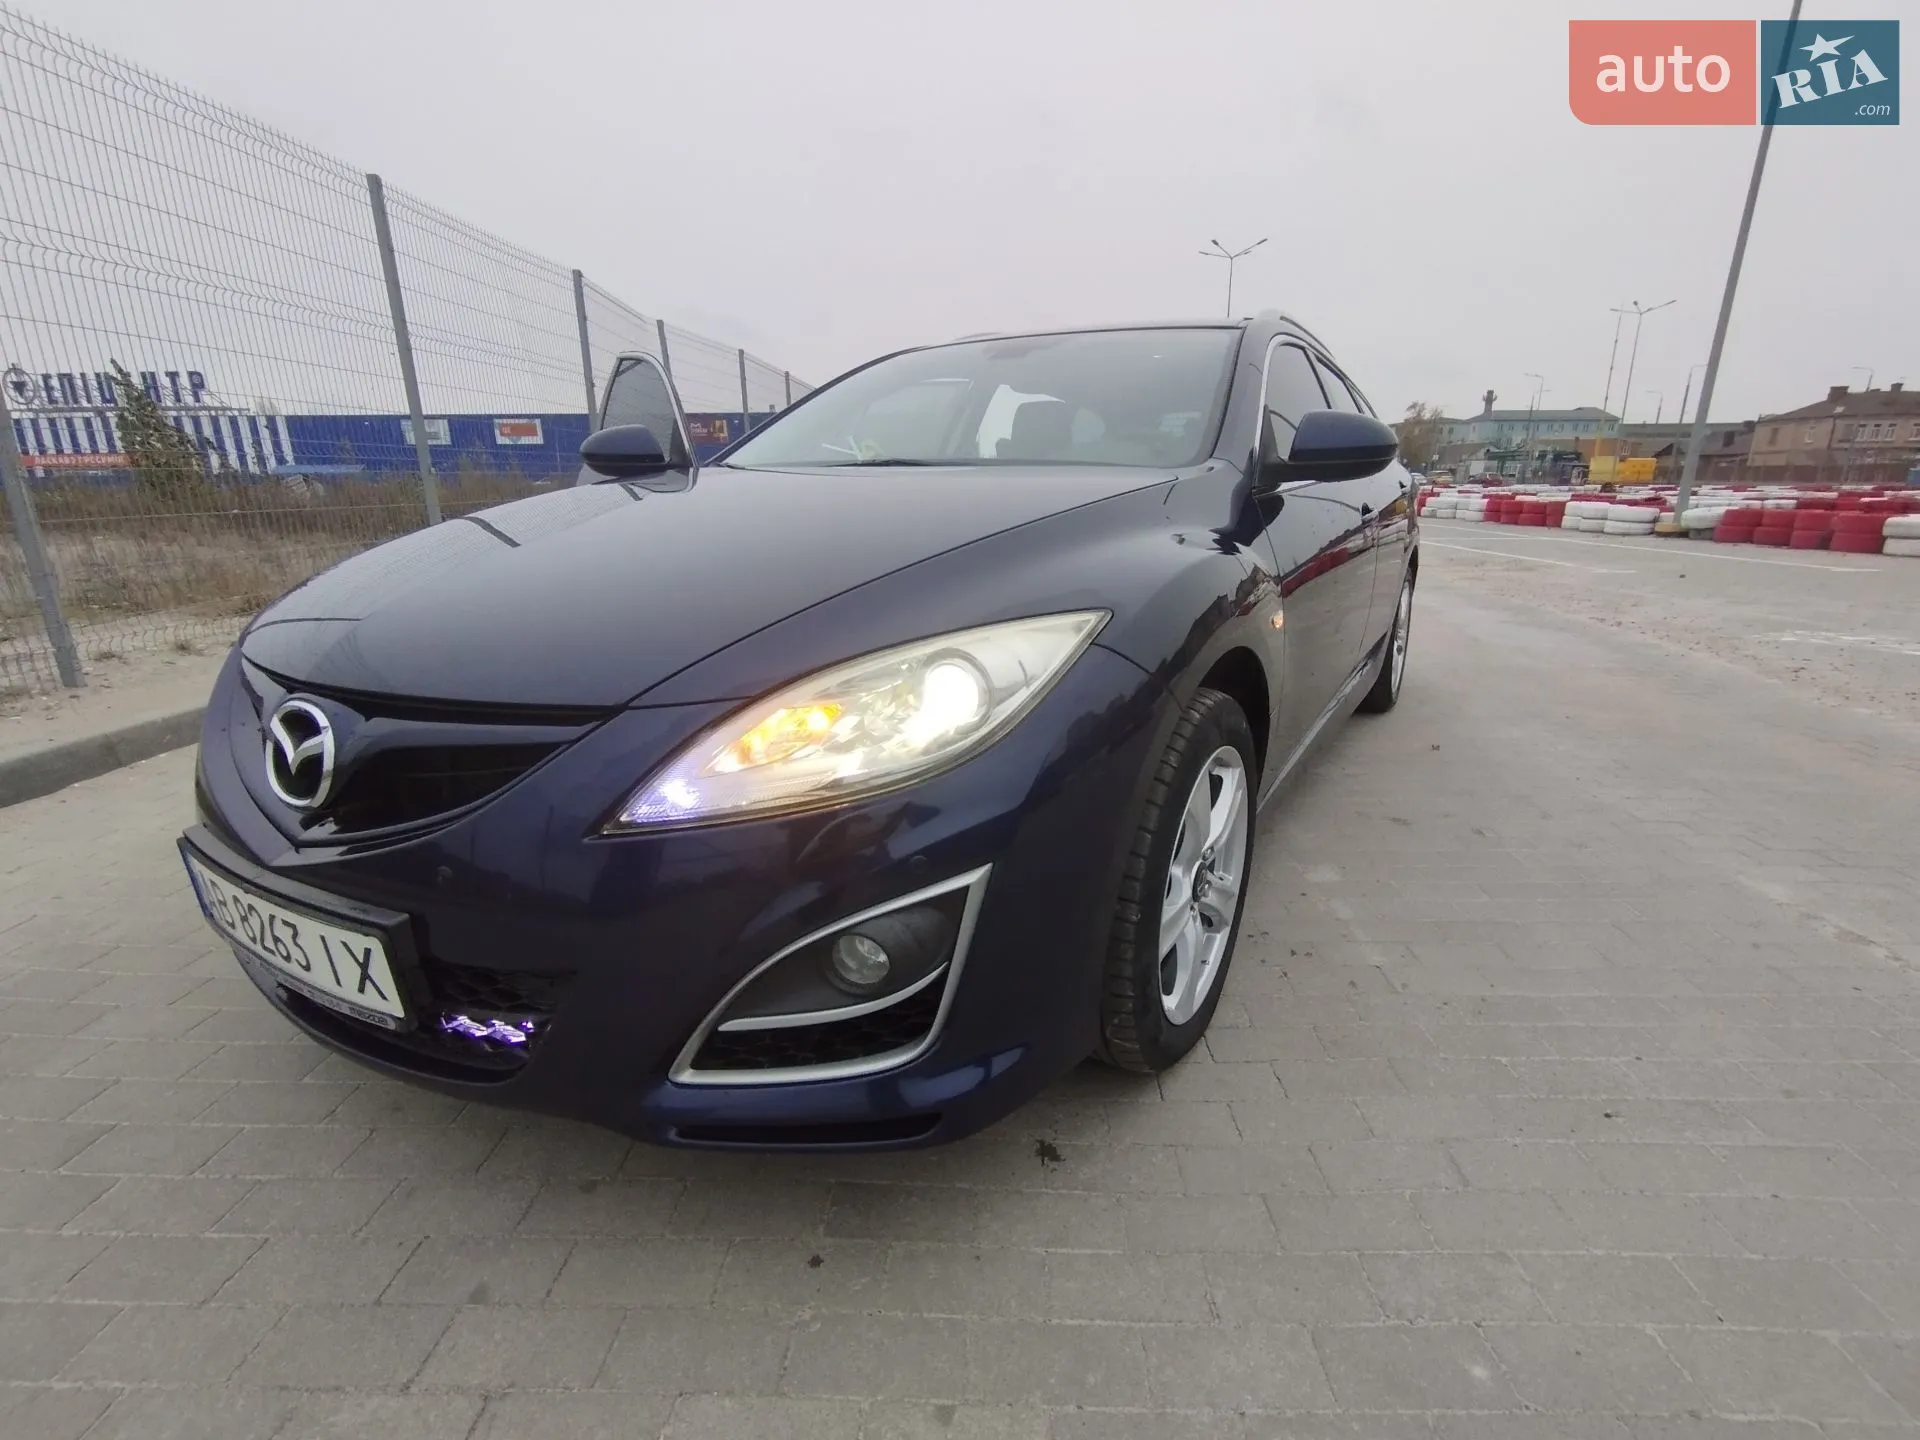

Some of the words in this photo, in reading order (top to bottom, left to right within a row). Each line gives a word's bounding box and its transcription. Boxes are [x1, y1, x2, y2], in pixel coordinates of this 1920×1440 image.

[41, 370, 205, 406] ЕПІЦНТР
[231, 894, 312, 973] 8263
[319, 934, 390, 1002] IX
